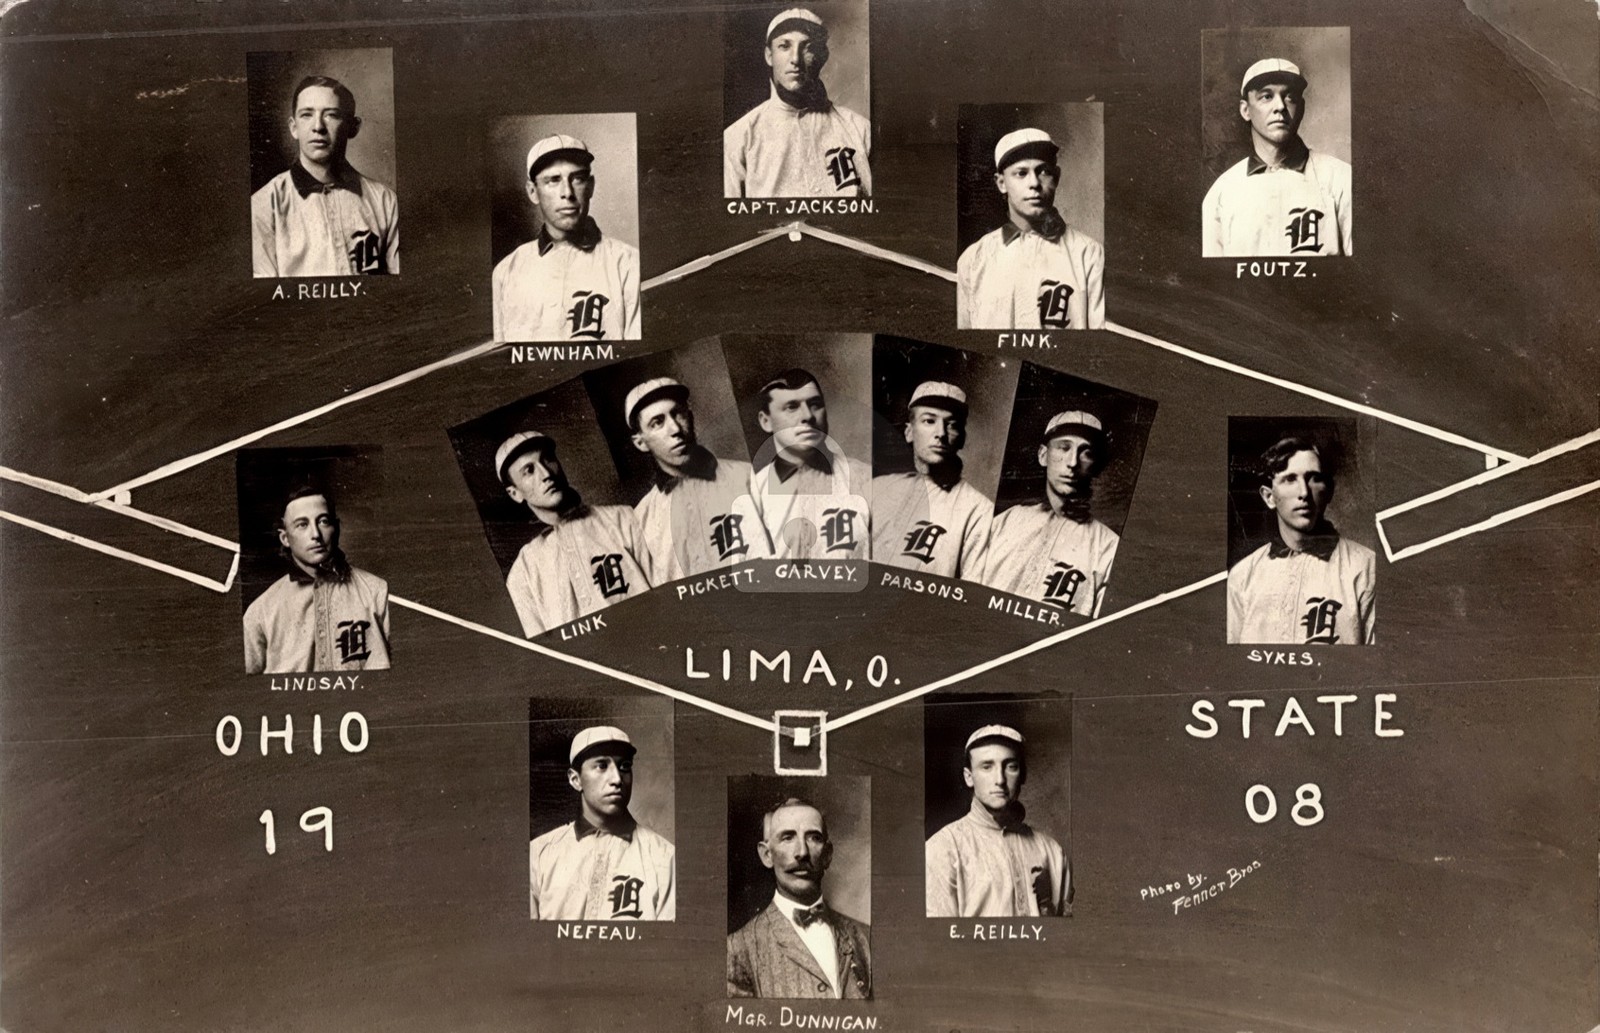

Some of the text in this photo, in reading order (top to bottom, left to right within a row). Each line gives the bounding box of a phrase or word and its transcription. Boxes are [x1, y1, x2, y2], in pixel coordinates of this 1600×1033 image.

[785, 199, 880, 215] JACKSON.
[1236, 261, 1317, 279] FOUTZ.
[271, 281, 367, 300] A. REILLY.
[998, 333, 1058, 350] FINK.
[511, 344, 620, 364] NEWNHAM.
[774, 563, 858, 583] GARVEY.
[676, 568, 761, 601] PICKETT.
[880, 571, 968, 603] PARSONS.
[987, 595, 1065, 627] MILLER.
[560, 614, 607, 641] LINK
[1246, 649, 1322, 667] SYKES.
[686, 647, 901, 691] LIMA, O.
[270, 675, 365, 692] LINDSAY.
[1185, 693, 1405, 739] STATE
[215, 711, 370, 757] OHIO
[1245, 782, 1325, 827] 08
[259, 806, 333, 855] 19
[1186, 873, 1208, 891] by.
[556, 923, 642, 941] NEFEAU.
[949, 923, 1047, 942] E. REILLY.
